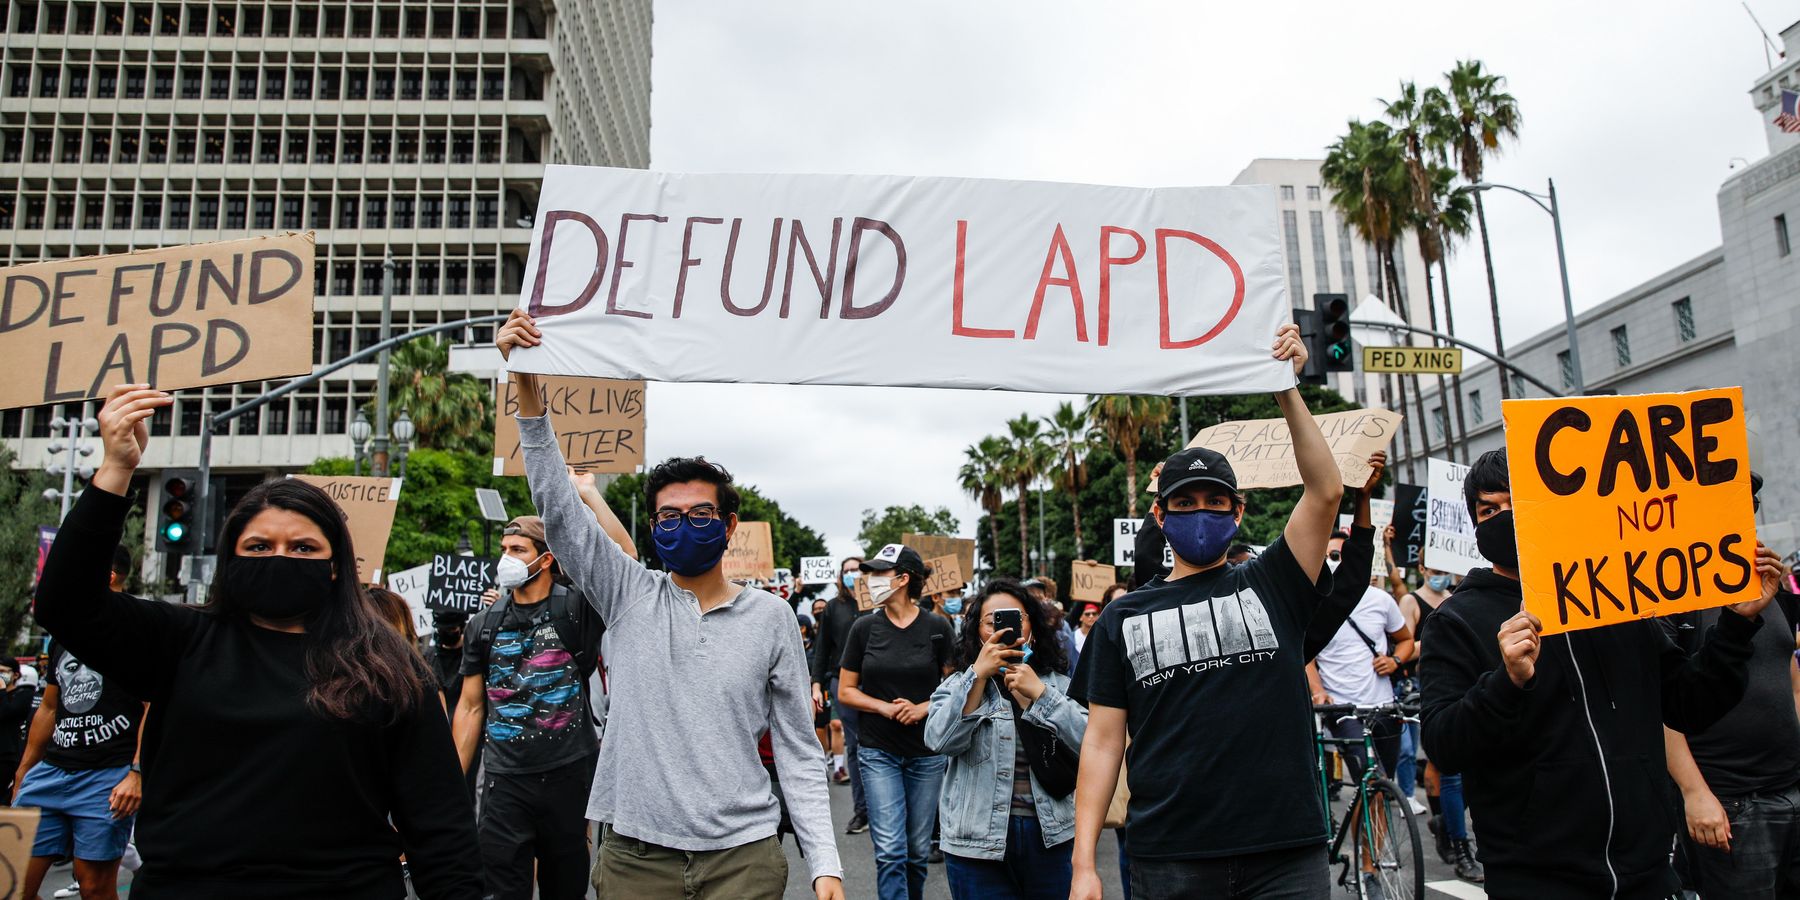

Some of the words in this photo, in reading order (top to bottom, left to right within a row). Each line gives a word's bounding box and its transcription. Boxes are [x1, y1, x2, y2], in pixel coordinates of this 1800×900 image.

[0, 249, 303, 334] DEFUND
[528, 209, 907, 320] DEFUND
[952, 220, 1246, 350] LAPD
[43, 318, 251, 402] LAPD
[1371, 351, 1406, 368] PED
[1413, 352, 1454, 369] XING
[504, 380, 582, 417] BACK
[588, 387, 643, 420] LIVES
[1205, 422, 1292, 446] BLAC
[1225, 442, 1296, 462] MATT
[1534, 397, 1738, 497] CARE
[1617, 493, 1678, 541] NOT
[1429, 531, 1457, 553] BLACK
[433, 554, 491, 584] BLACK
[805, 559, 833, 569] FUCK
[444, 577, 484, 592] LIVES
[922, 570, 958, 594] IVES
[1075, 572, 1094, 590] NO
[1142, 668, 1176, 689] NEW
[1182, 657, 1233, 675] YORK
[1238, 650, 1276, 664] CITY
[64, 690, 101, 706] BREATHE
[84, 714, 131, 746] FLOYD
[85, 714, 104, 727] FOR
